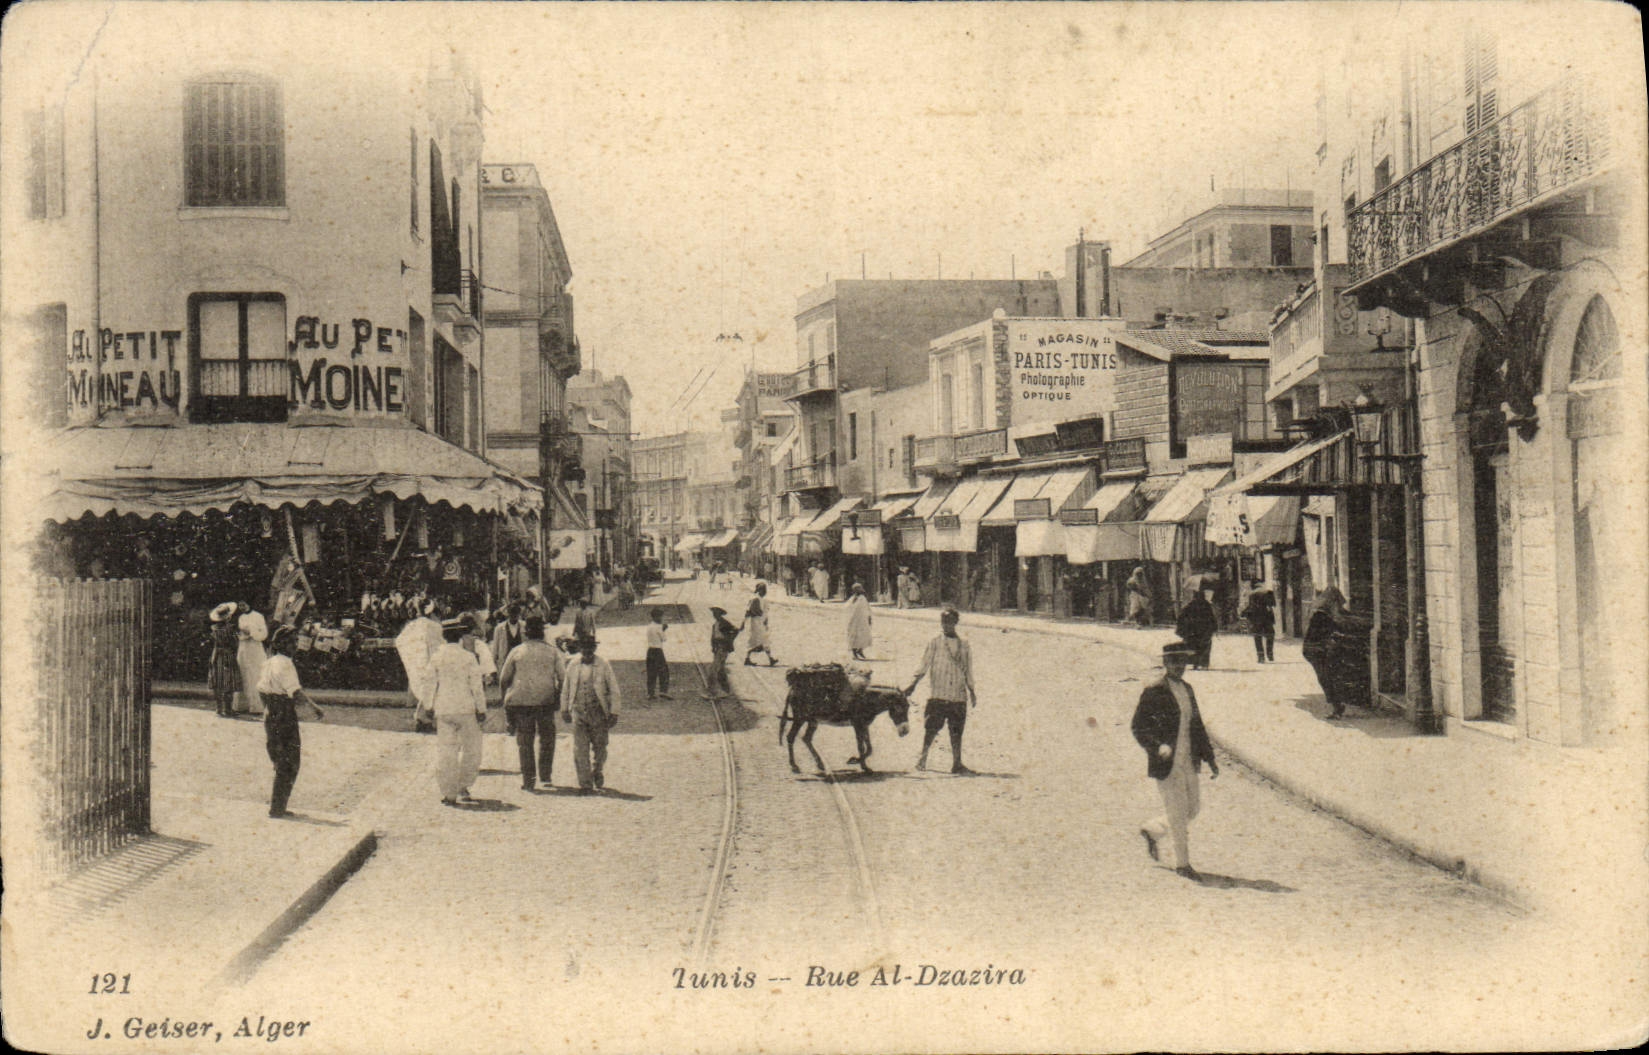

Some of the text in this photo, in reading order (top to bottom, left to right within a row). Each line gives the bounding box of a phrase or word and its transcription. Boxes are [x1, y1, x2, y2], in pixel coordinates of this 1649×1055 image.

[98, 327, 182, 361] PETIT
[288, 315, 339, 354] AU
[1038, 333, 1099, 348] MAGASIN
[1014, 351, 1117, 370] PARIS-TUNIS
[287, 358, 406, 412] MOINE
[1020, 371, 1086, 390] Photographie
[1023, 390, 1072, 402] OPTIQUE
